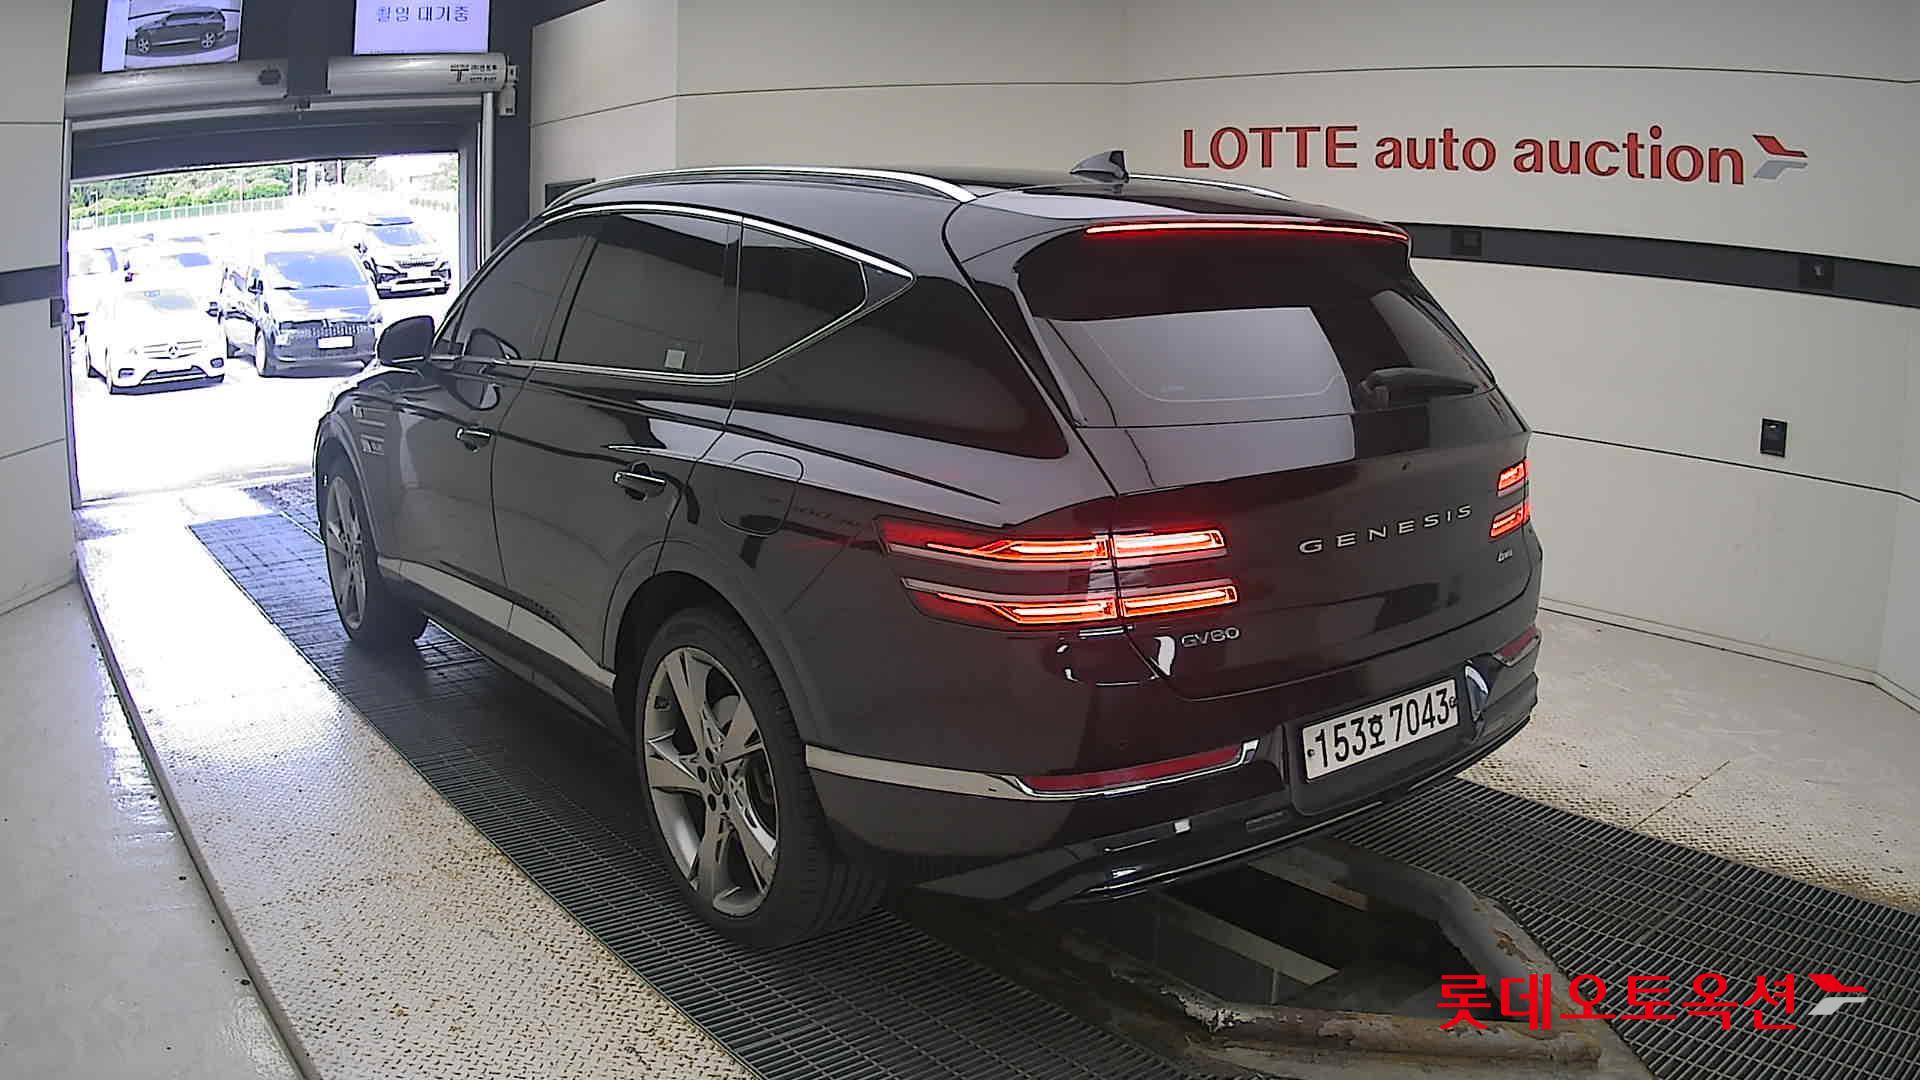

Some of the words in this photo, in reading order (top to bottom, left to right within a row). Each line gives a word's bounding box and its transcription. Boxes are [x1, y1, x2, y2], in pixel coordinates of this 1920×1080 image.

[1183, 125, 1358, 170] LOTTE
[1374, 127, 1497, 172] auto
[1513, 125, 1744, 185] auction
[1299, 505, 1472, 553] GENESIS
[1181, 627, 1240, 648] GV80
[1315, 714, 1386, 768] 153호
[1389, 687, 1450, 742] 7043
